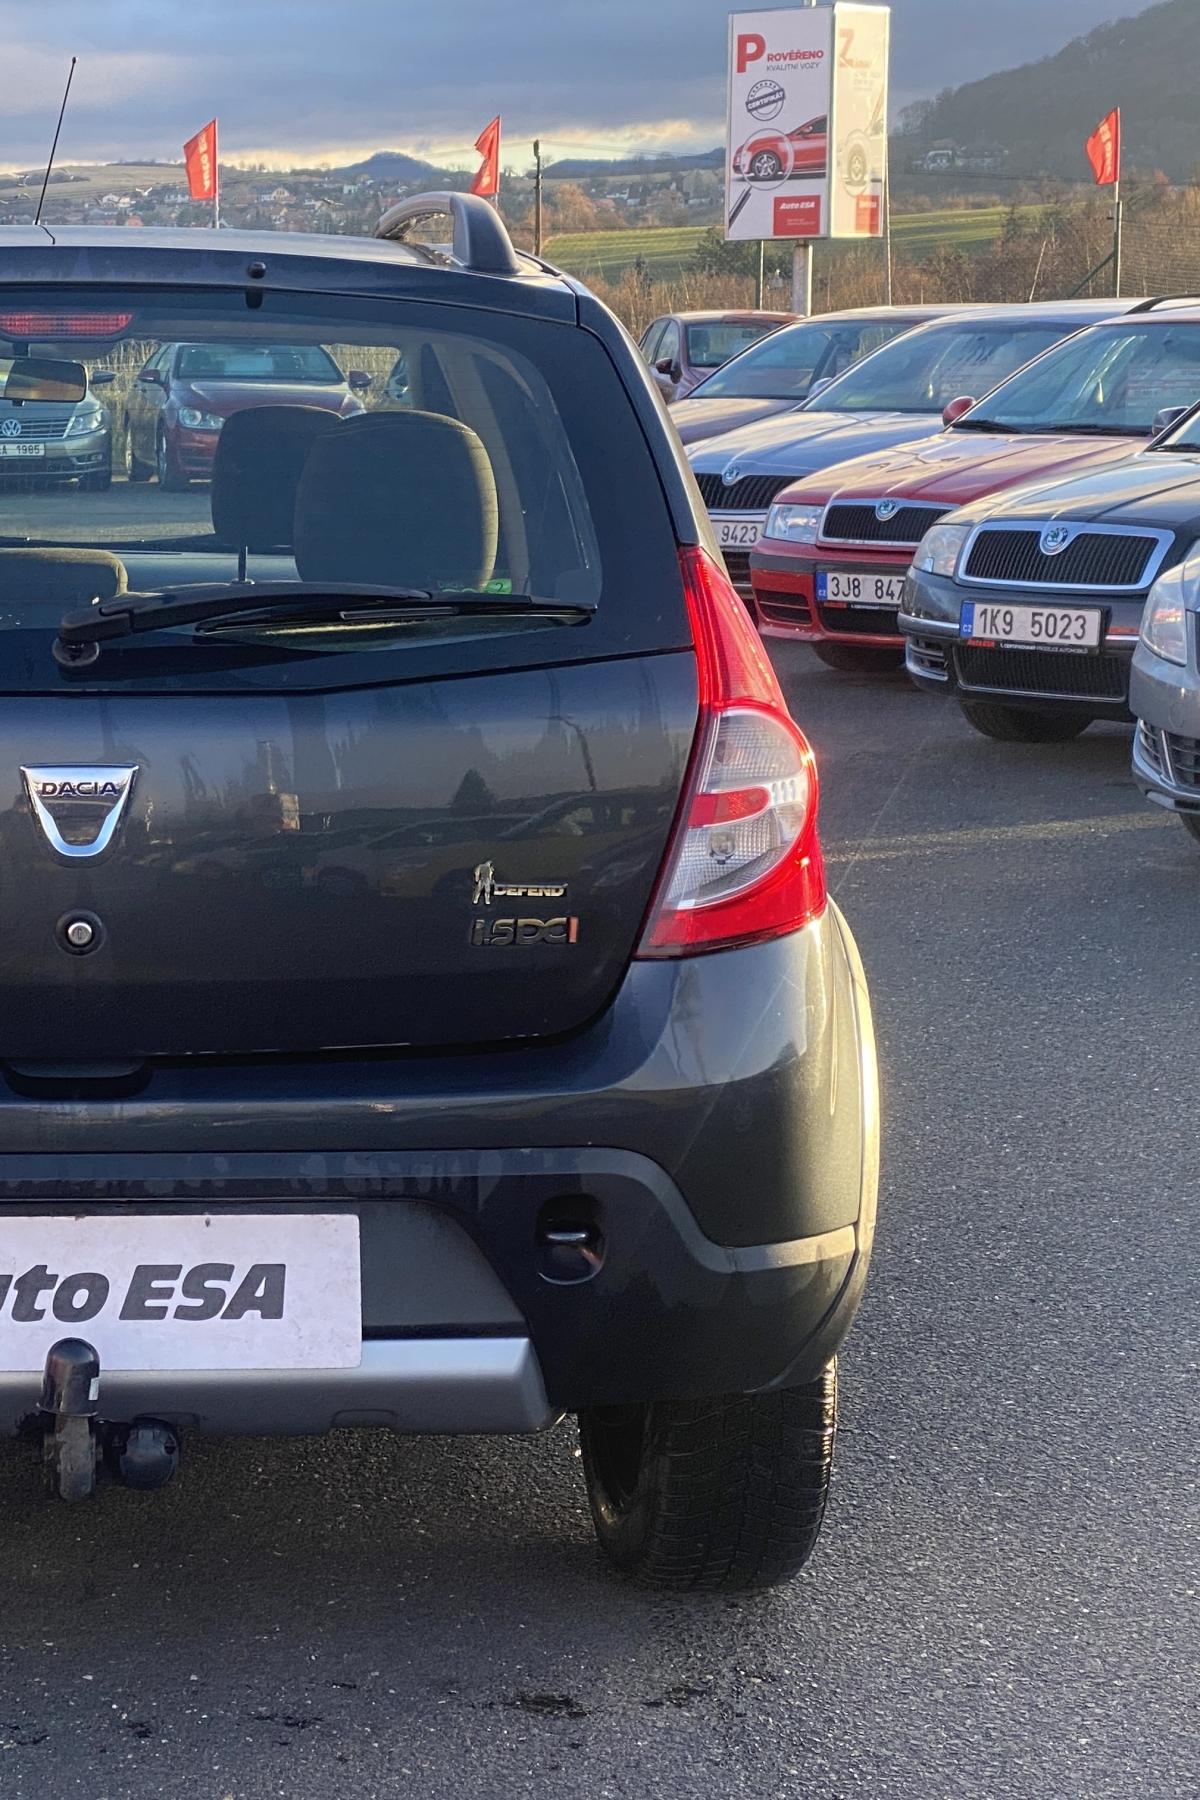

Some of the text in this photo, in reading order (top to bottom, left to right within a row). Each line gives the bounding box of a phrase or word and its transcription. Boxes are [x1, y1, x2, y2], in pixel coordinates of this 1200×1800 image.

[721, 525, 758, 544] 9423
[831, 576, 861, 598] 3J8
[963, 624, 972, 632] CZ
[980, 608, 1087, 640] 1K9 5023
[41, 781, 119, 797] DACIA
[493, 885, 565, 897] DEFEND
[118, 1262, 287, 1322] ESA
